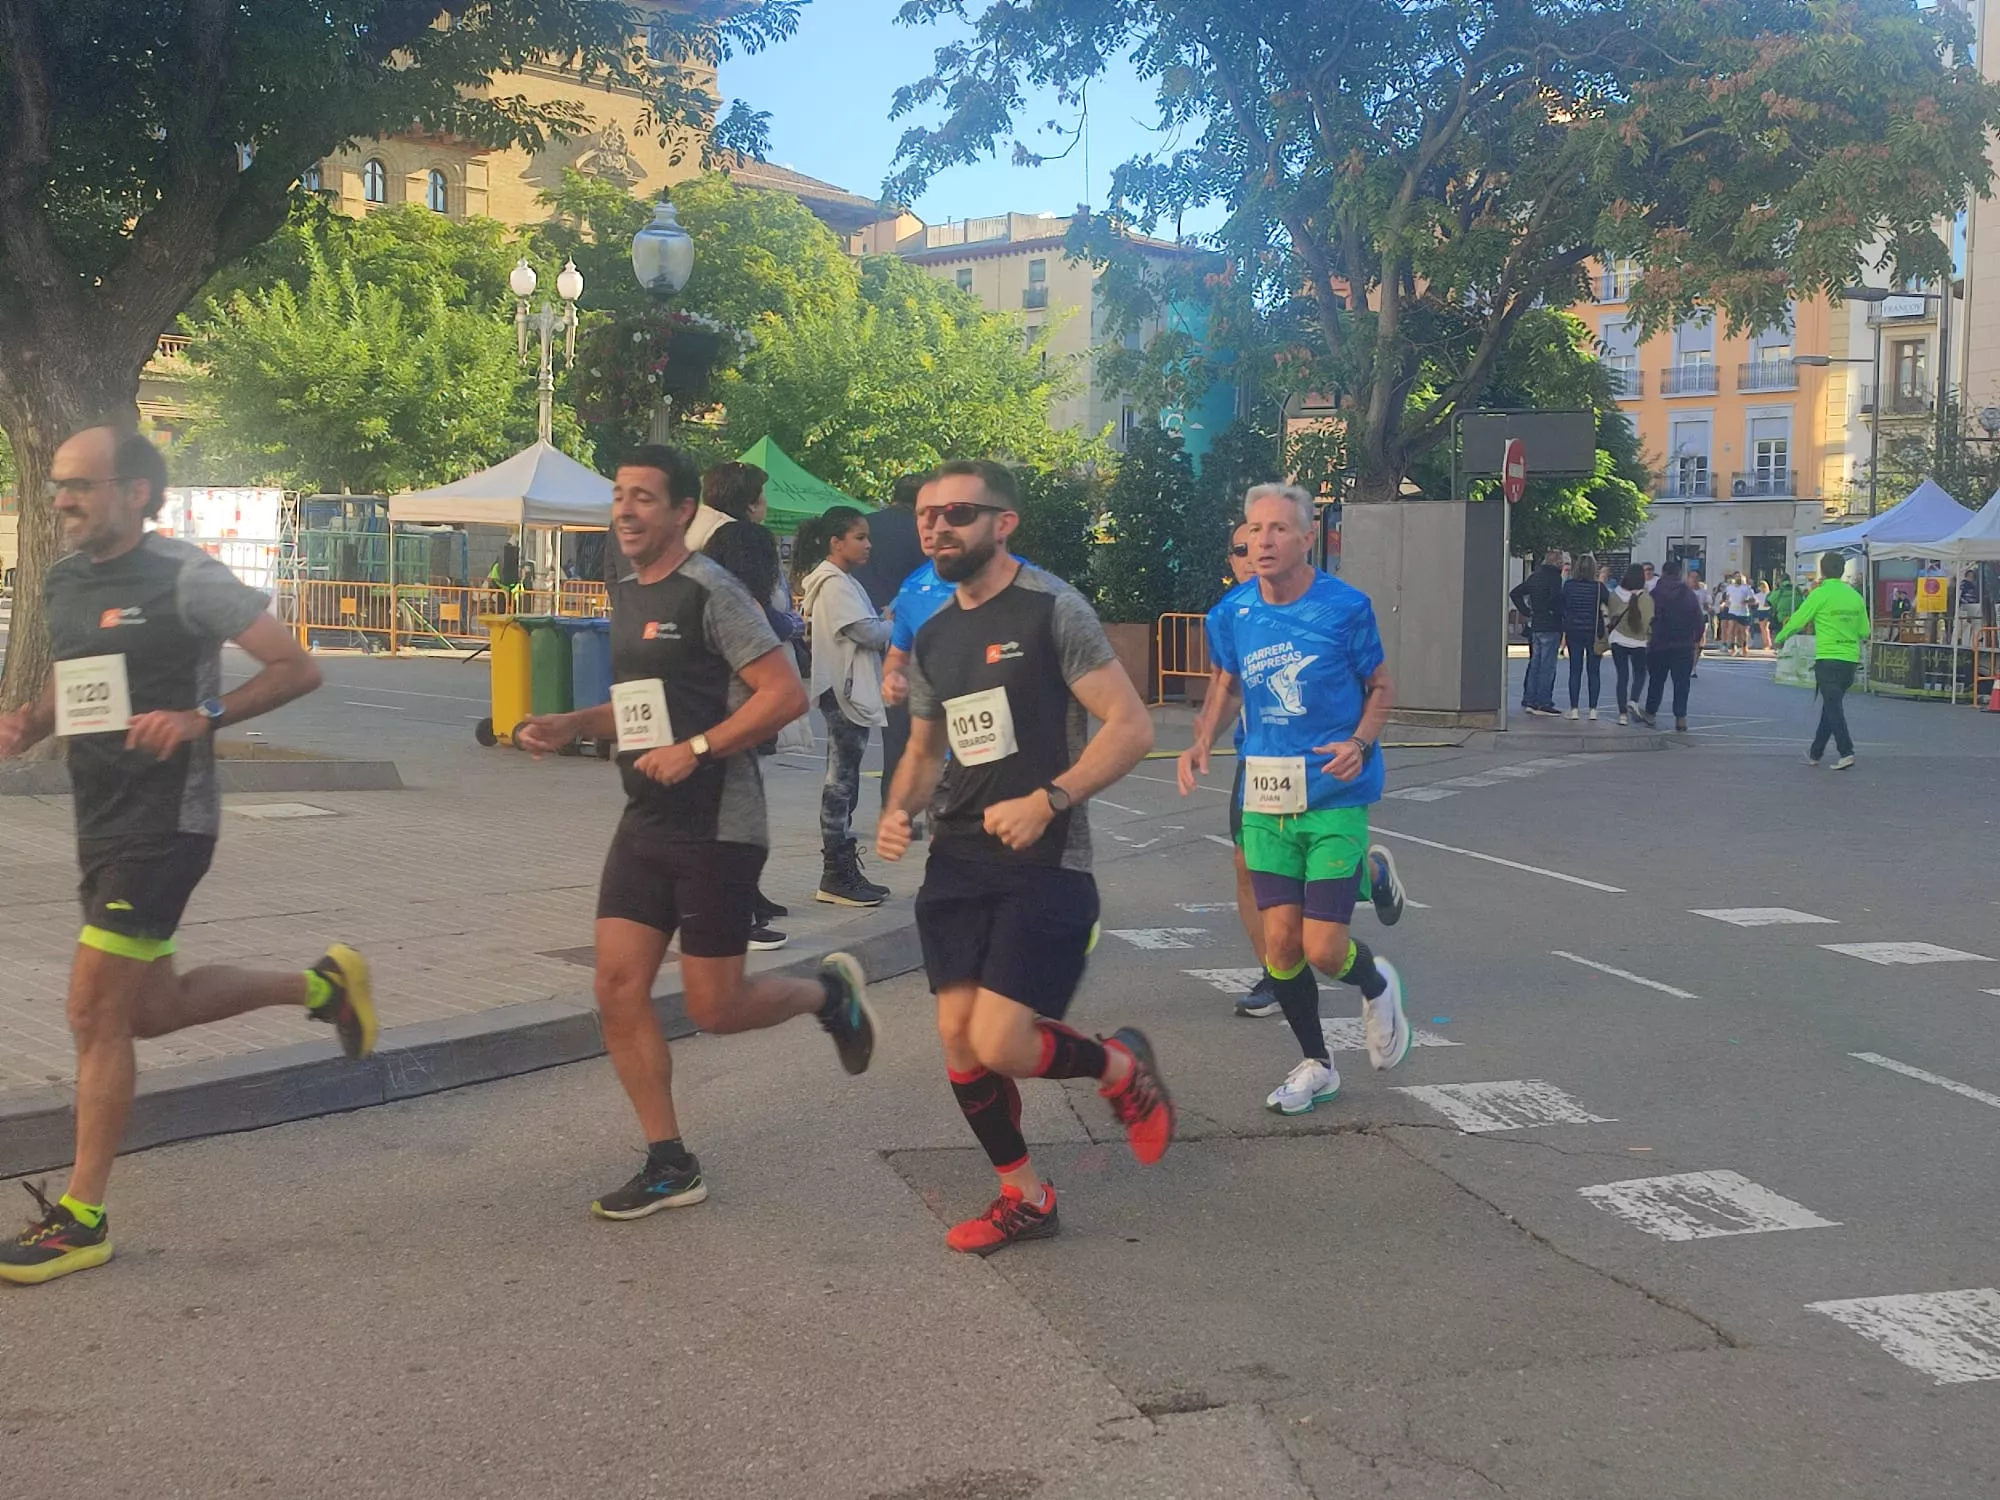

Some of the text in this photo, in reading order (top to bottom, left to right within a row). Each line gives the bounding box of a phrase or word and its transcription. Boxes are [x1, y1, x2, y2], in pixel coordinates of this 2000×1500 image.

[1246, 641, 1294, 665] CARRERA
[1247, 650, 1302, 676] EMPRESAS
[953, 711, 994, 736] 1019
[1253, 776, 1292, 792] 1034
[1261, 794, 1281, 802] JUAN
